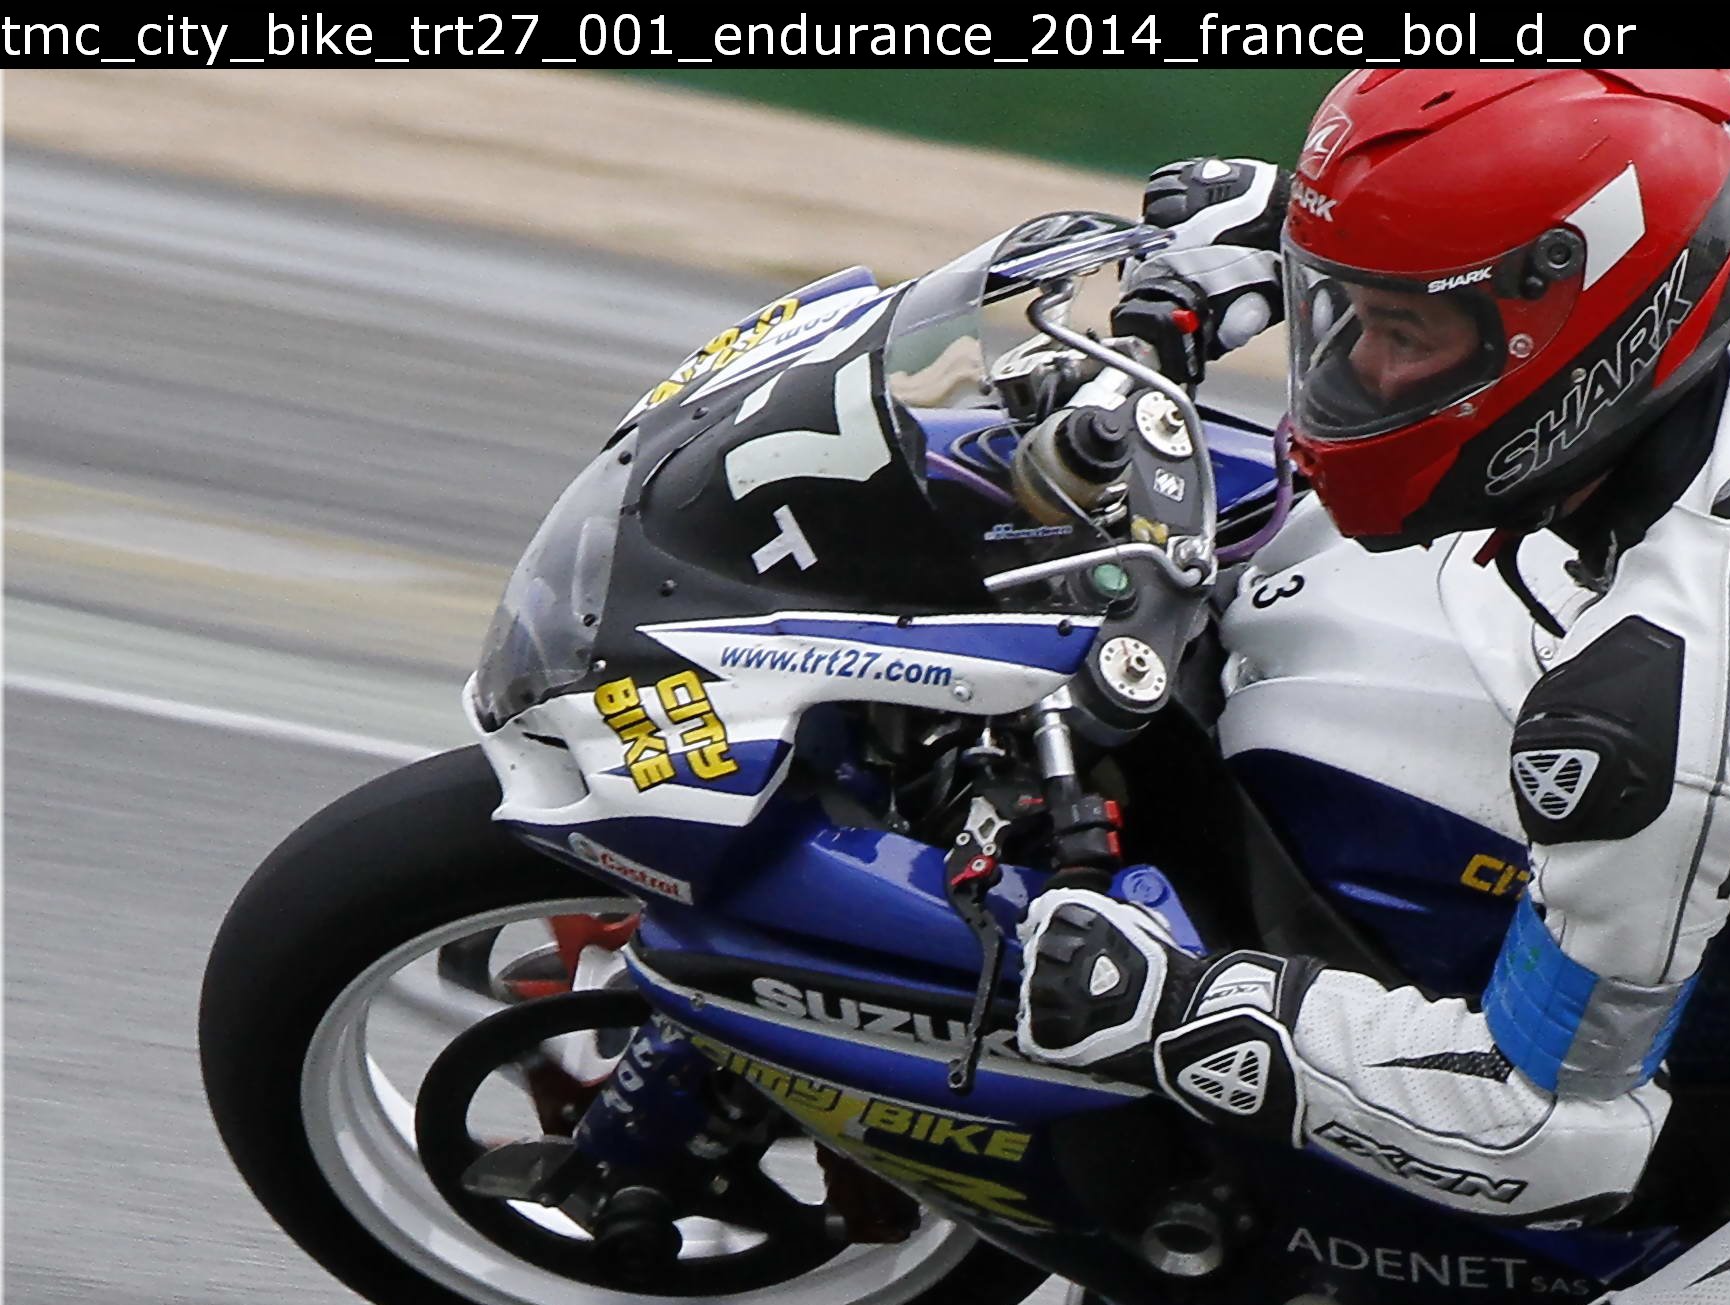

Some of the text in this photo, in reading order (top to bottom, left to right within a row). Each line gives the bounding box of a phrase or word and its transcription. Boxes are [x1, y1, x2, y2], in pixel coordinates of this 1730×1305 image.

[1428, 266, 1492, 293] SHARK
[1485, 249, 1692, 496] SHARK
[752, 504, 818, 575] T
[720, 646, 952, 687] www.trt27.com
[592, 675, 678, 794] BIKE
[654, 669, 740, 781] CITY
[598, 850, 680, 898] Castrol
[752, 976, 1026, 1057] SUZUK
[862, 1097, 1033, 1163] BIKE
[1287, 1226, 1590, 1297] ADENET SAS
